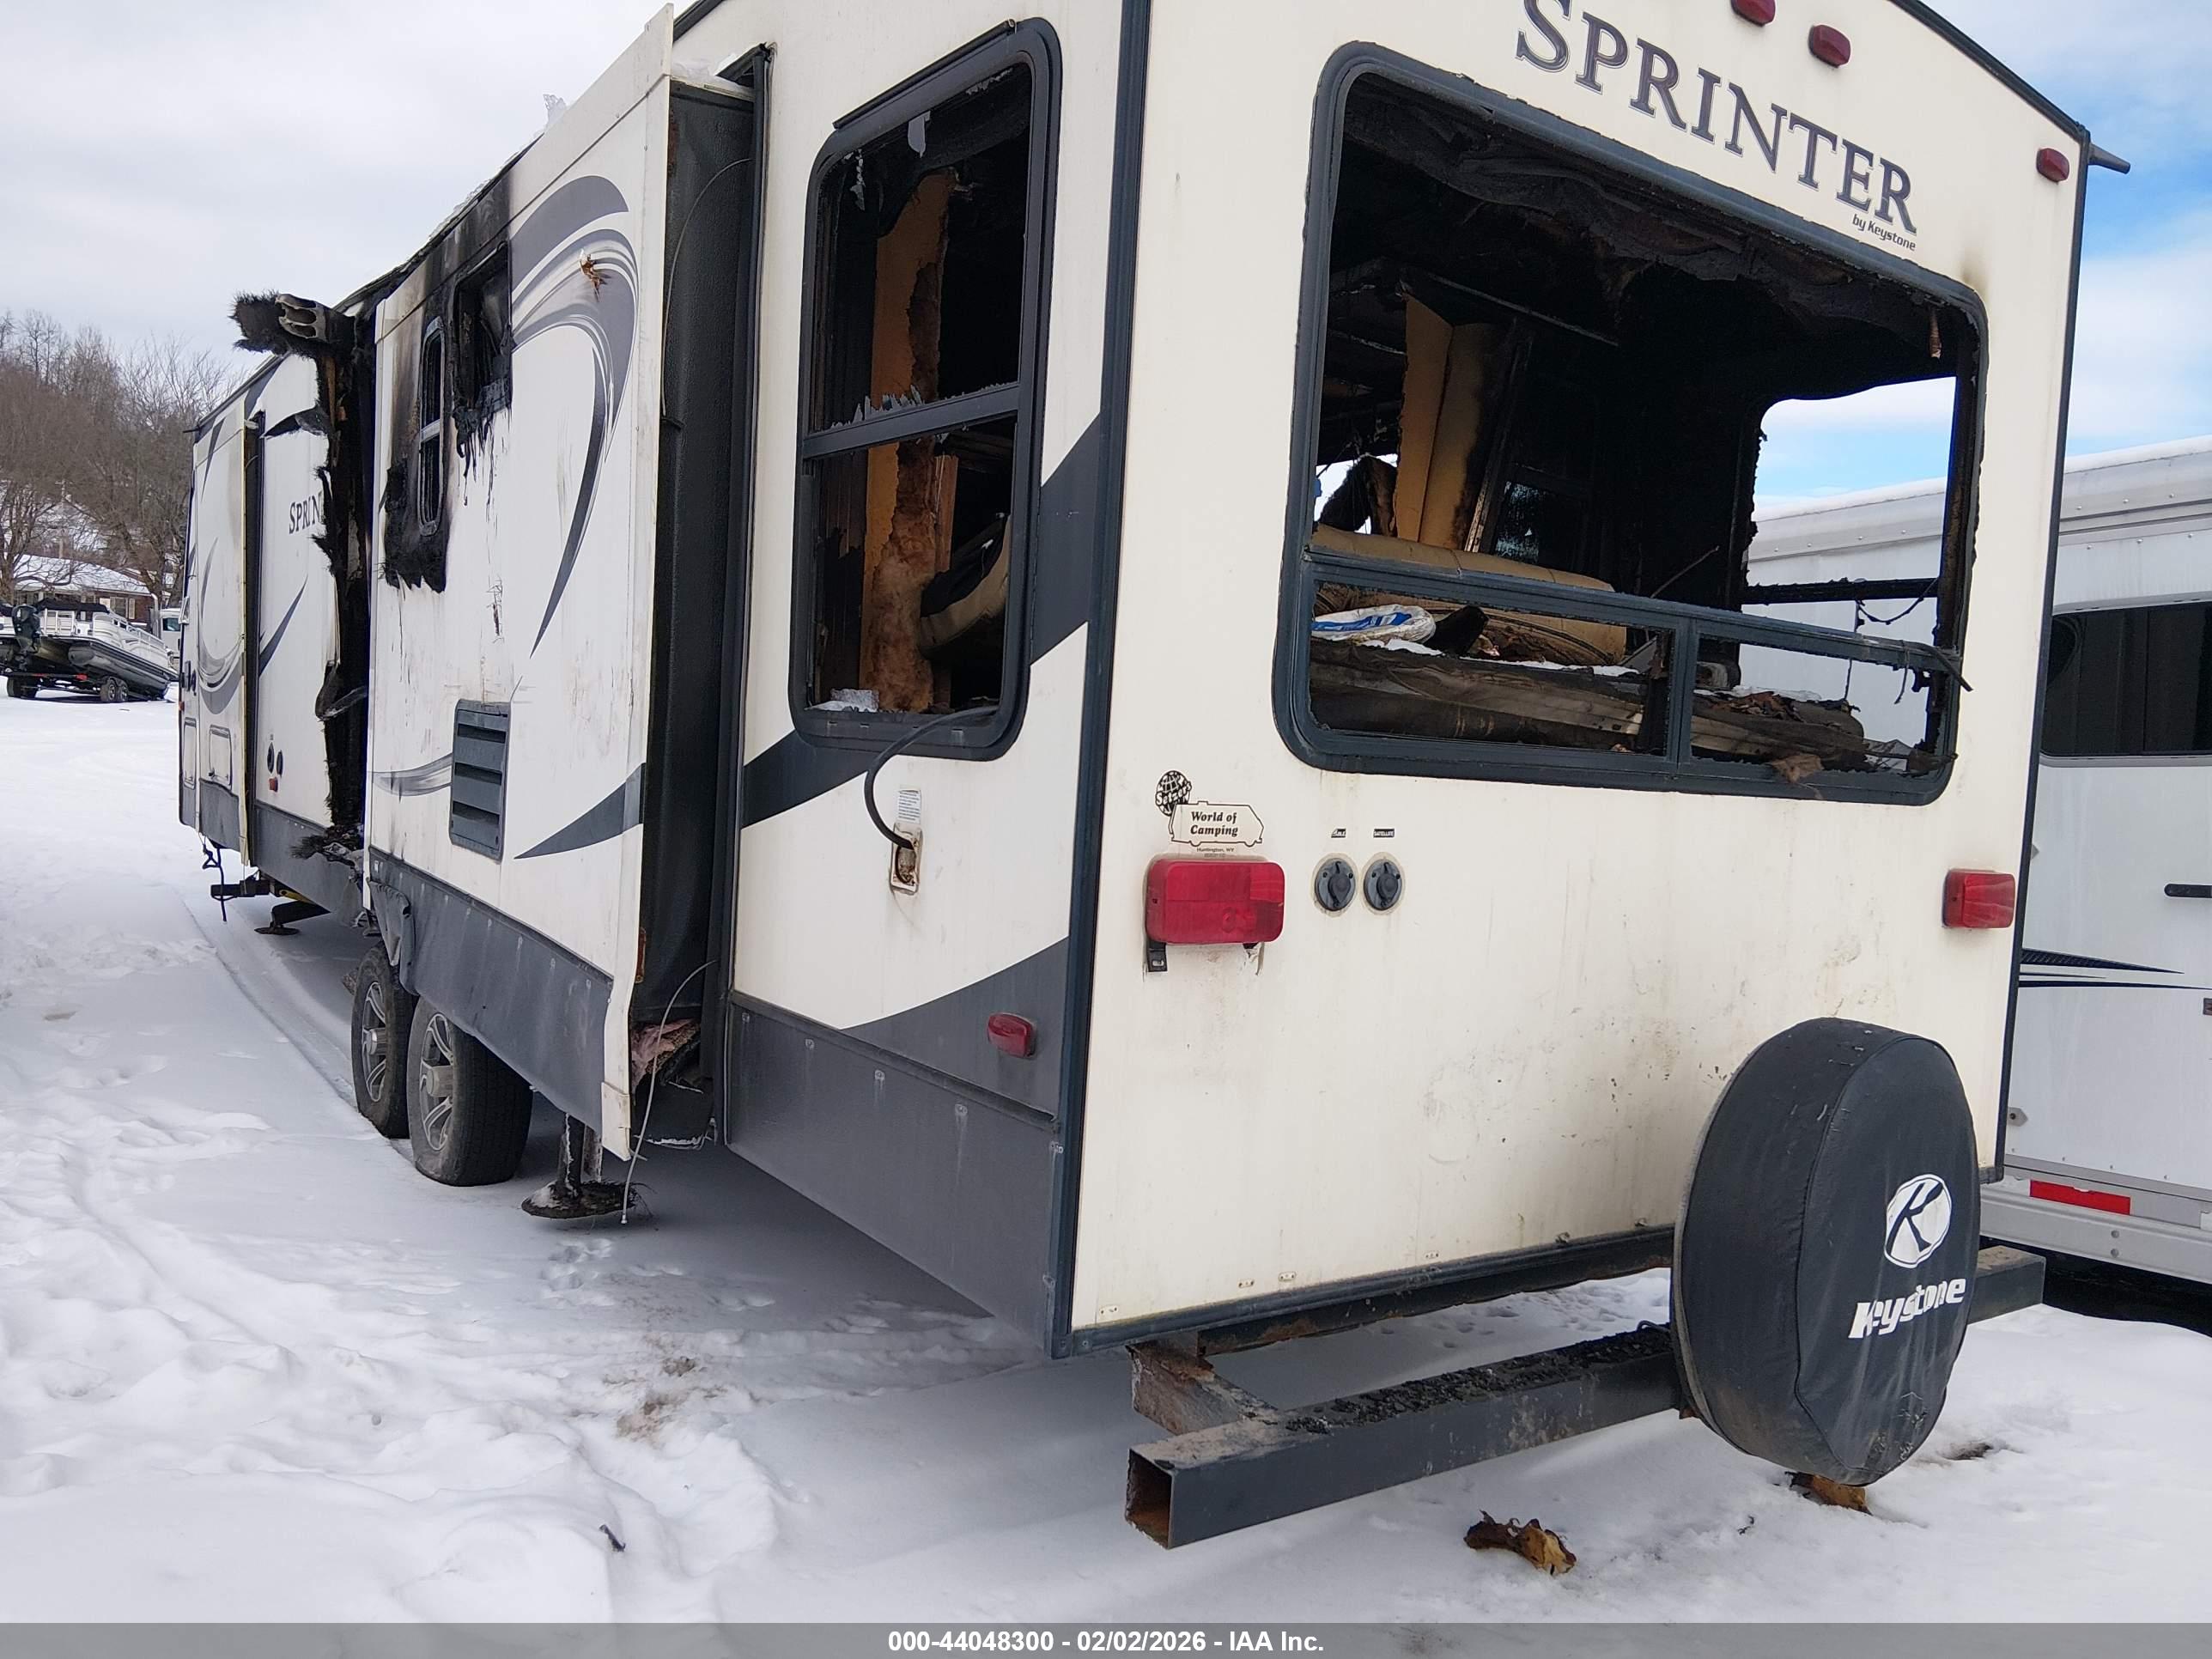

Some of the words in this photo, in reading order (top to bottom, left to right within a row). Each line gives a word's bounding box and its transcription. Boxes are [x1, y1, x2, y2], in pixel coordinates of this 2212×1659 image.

[1516, 0, 1918, 235] SPRINTER
[1852, 214, 1867, 231] by
[1868, 221, 1916, 252] Keystone
[289, 489, 324, 534] SPRIN
[1190, 811, 1223, 823] World
[1225, 811, 1237, 824] of
[1190, 824, 1238, 837] Camping
